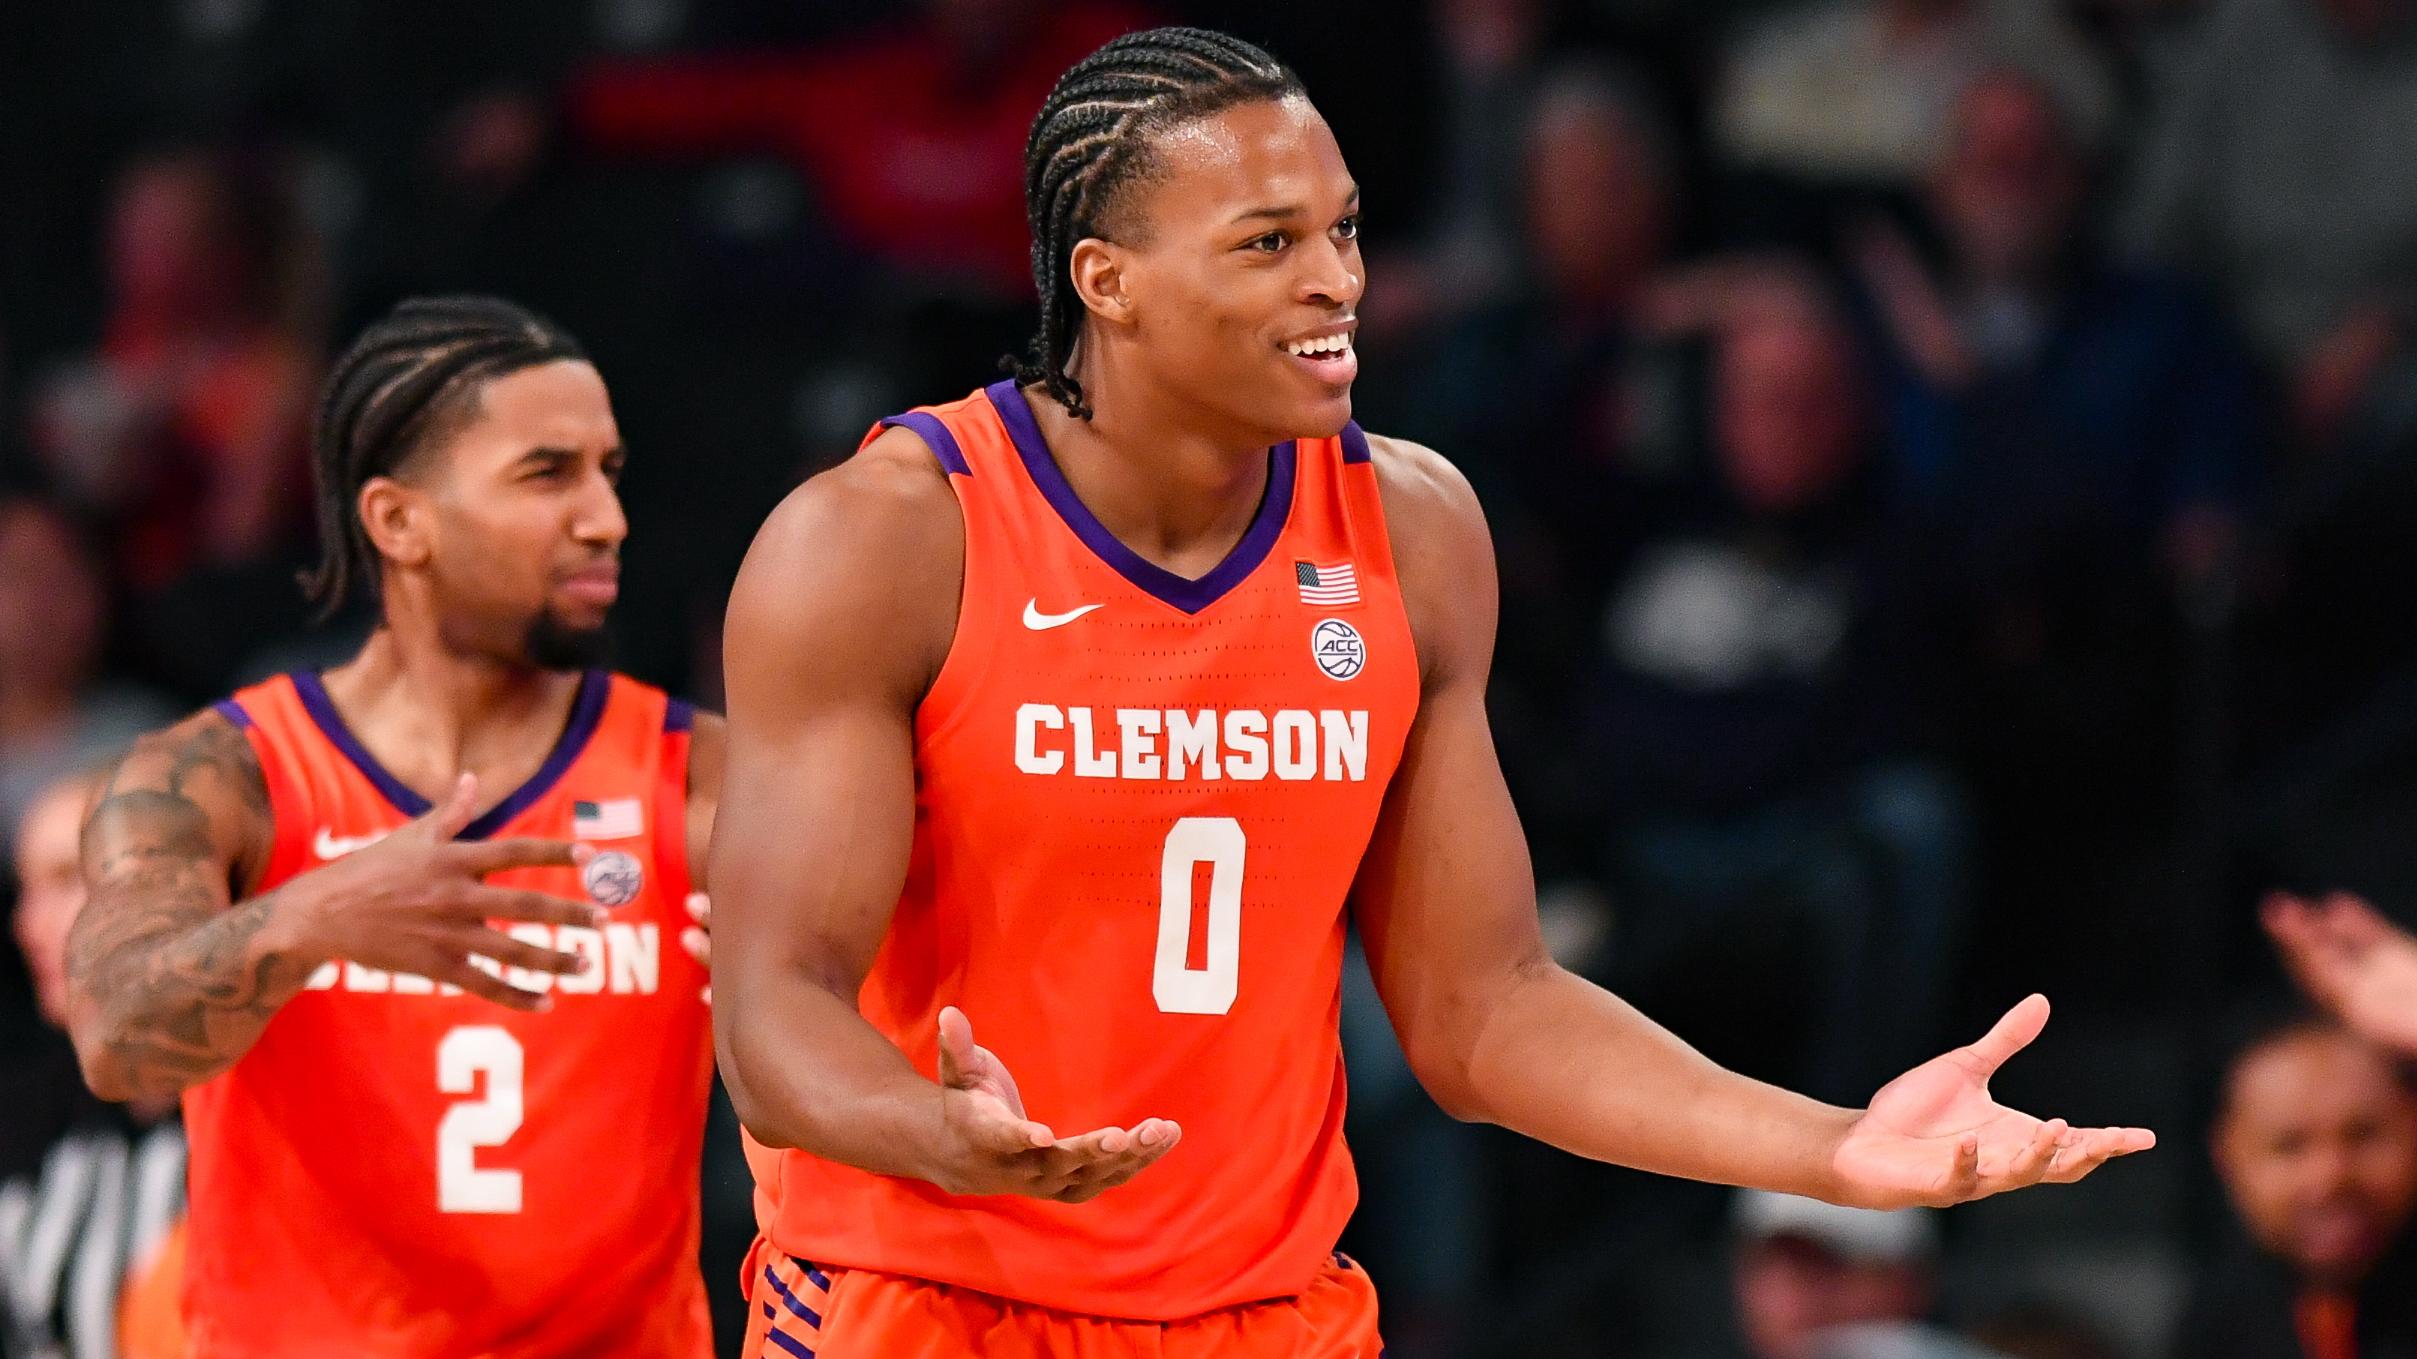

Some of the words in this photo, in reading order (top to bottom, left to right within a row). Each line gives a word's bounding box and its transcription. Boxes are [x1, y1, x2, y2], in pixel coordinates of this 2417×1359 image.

[1321, 639, 1358, 652] ACC
[1014, 703, 1370, 782] CLEMSON
[1152, 817, 1246, 1016] 0
[437, 1025, 525, 1214] 2
